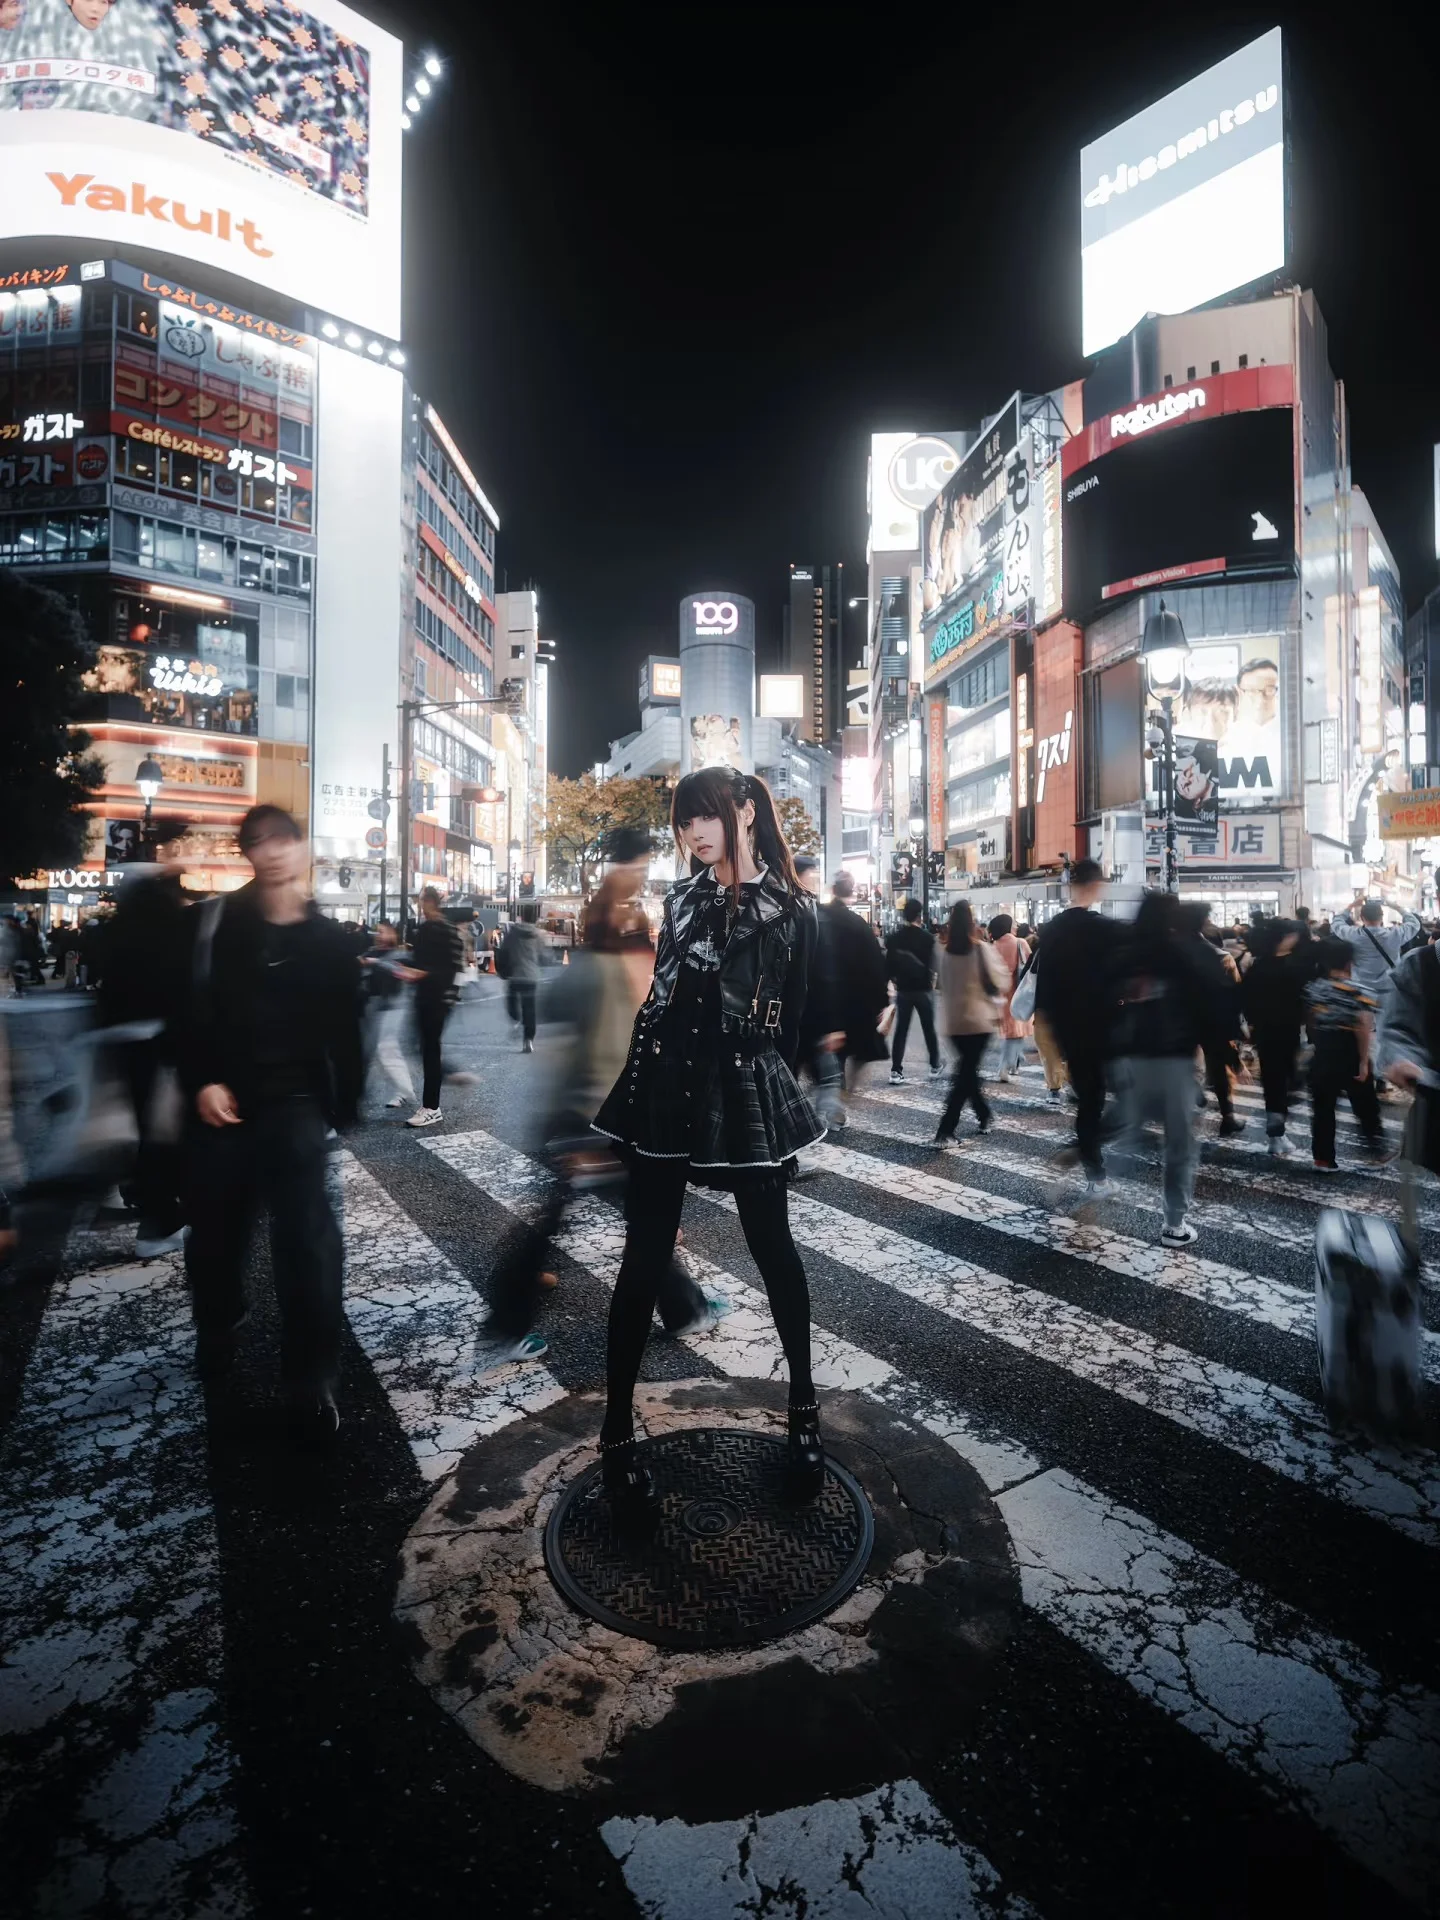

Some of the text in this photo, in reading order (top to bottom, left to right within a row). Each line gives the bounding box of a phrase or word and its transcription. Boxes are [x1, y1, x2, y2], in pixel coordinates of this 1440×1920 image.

[45, 171, 274, 258] Yakult
[143, 273, 309, 349] しゃぶしゃぶバイキング
[116, 368, 275, 442] コンタクト
[1110, 387, 1206, 438] Rakuten
[23, 412, 85, 442] ガスト
[227, 449, 298, 485] ガスト
[1067, 475, 1099, 502] SHIBUYA
[182, 507, 311, 548] 英会話イーオン
[1162, 566, 1187, 579] Vision
[693, 601, 738, 634] 109
